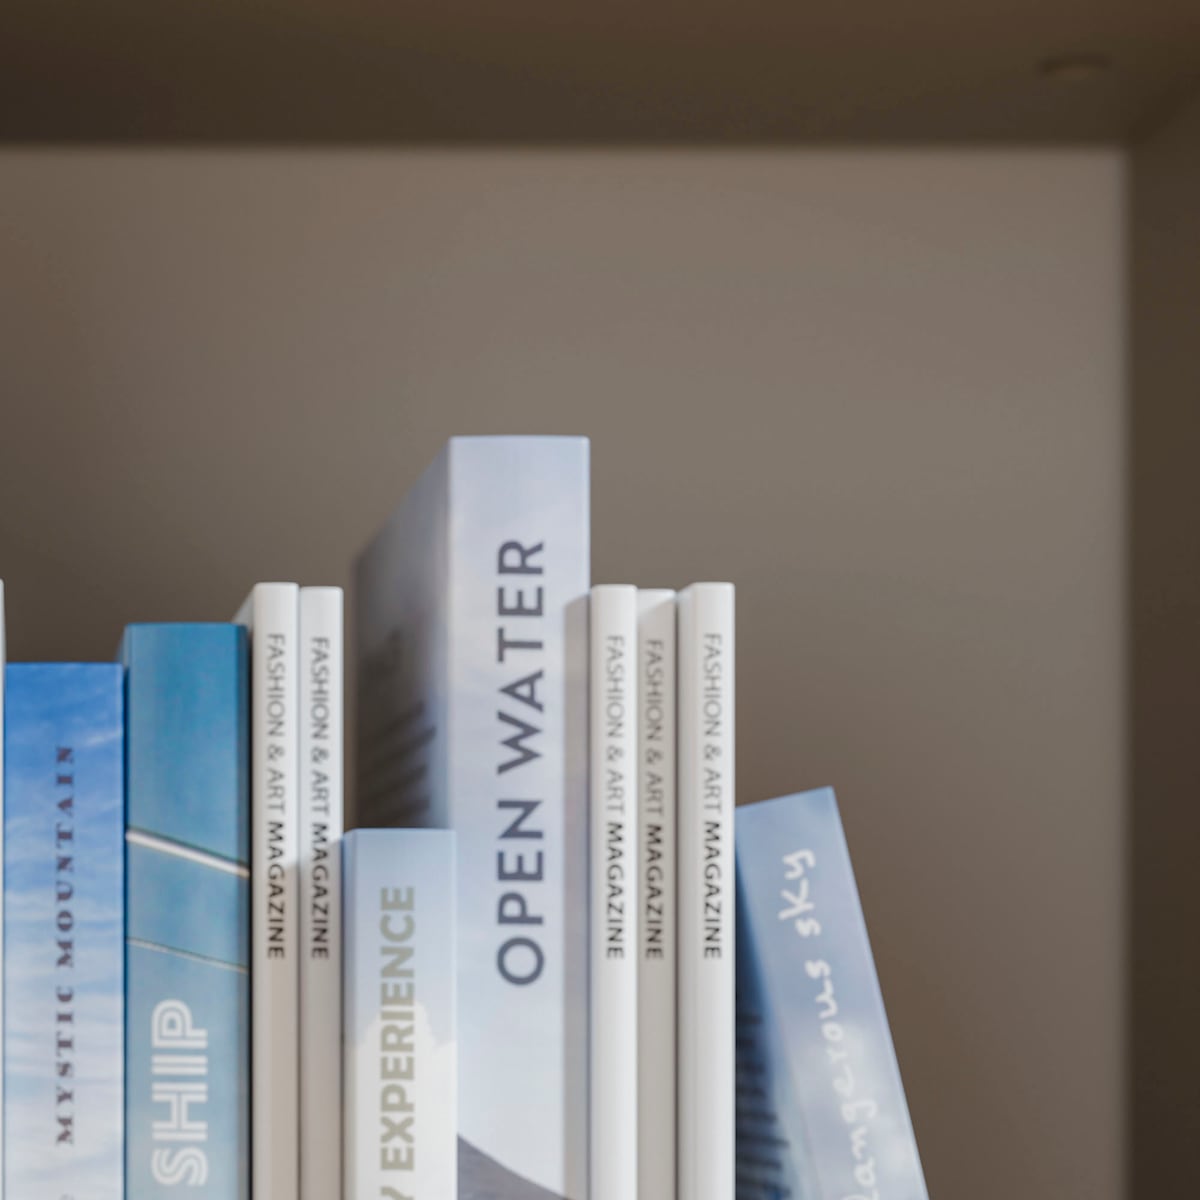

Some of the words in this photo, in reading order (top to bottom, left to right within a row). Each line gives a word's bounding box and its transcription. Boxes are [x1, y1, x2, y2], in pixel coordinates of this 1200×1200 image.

[266, 633, 286, 737] FASHION
[310, 637, 330, 740] FASHION
[497, 540, 546, 775] WATER
[606, 635, 625, 738] FASHION
[645, 640, 665, 742] FASHION
[703, 633, 723, 737] FASHION
[266, 743, 286, 761] &
[266, 768, 286, 814] ART
[310, 746, 330, 763] &
[310, 769, 330, 816] ART
[606, 746, 625, 761] &
[606, 769, 625, 815] ART
[645, 748, 665, 764] &
[645, 771, 665, 816] ART
[703, 744, 723, 761] &
[703, 768, 723, 813] ART
[55, 746, 75, 968] MOUNTAIN
[266, 821, 286, 959] MAGAZINE
[310, 822, 330, 959] MAGAZINE
[497, 800, 546, 987] OPEN
[606, 821, 625, 959] MAGAZINE
[645, 823, 665, 960] MAGAZINE
[703, 820, 723, 960] MAGAZINE
[778, 848, 821, 937] sky
[55, 986, 75, 1146] MYSTIC
[379, 886, 416, 1172] EXPERIENCE
[150, 998, 209, 1186] SHIP
